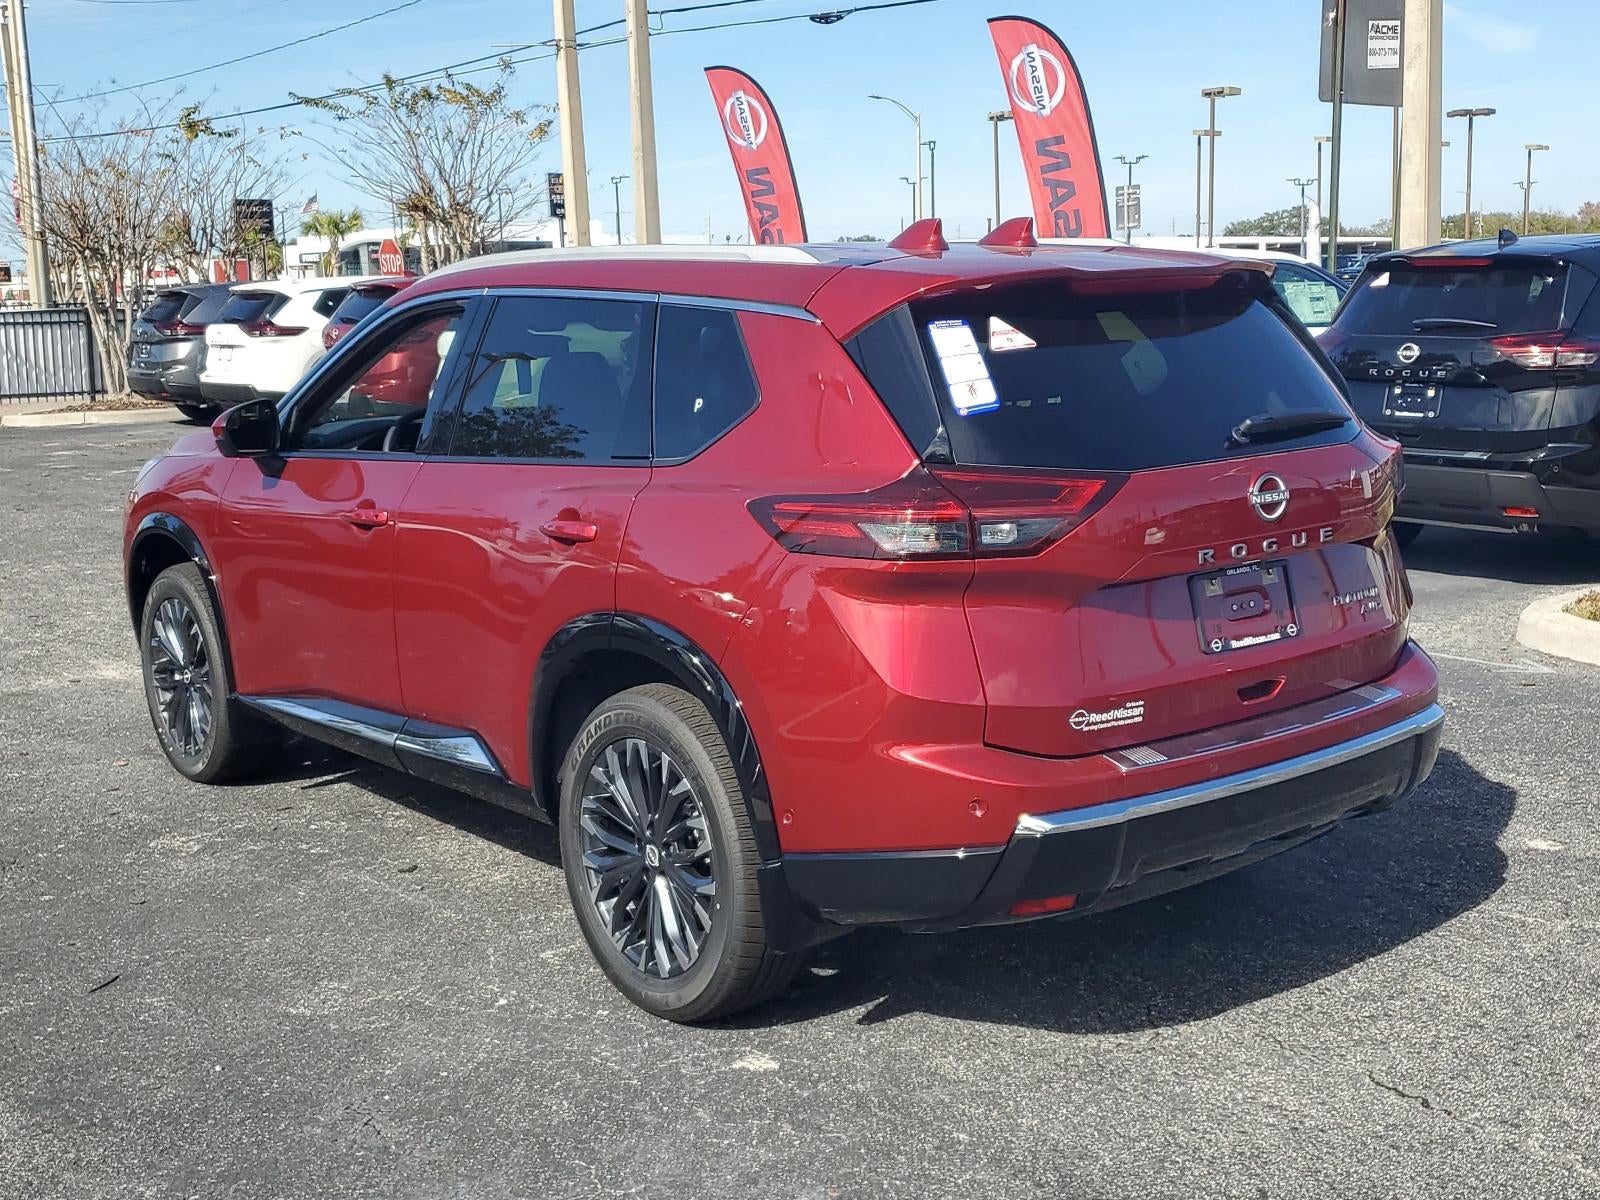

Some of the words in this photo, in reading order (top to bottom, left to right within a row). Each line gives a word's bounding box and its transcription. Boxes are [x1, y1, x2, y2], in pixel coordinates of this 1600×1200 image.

[1375, 24, 1399, 35] ACME
[382, 253, 402, 273] STOP
[1369, 368, 1447, 378] ROGUE
[1252, 490, 1290, 504] NISSAN
[1198, 527, 1334, 565] ROGUE
